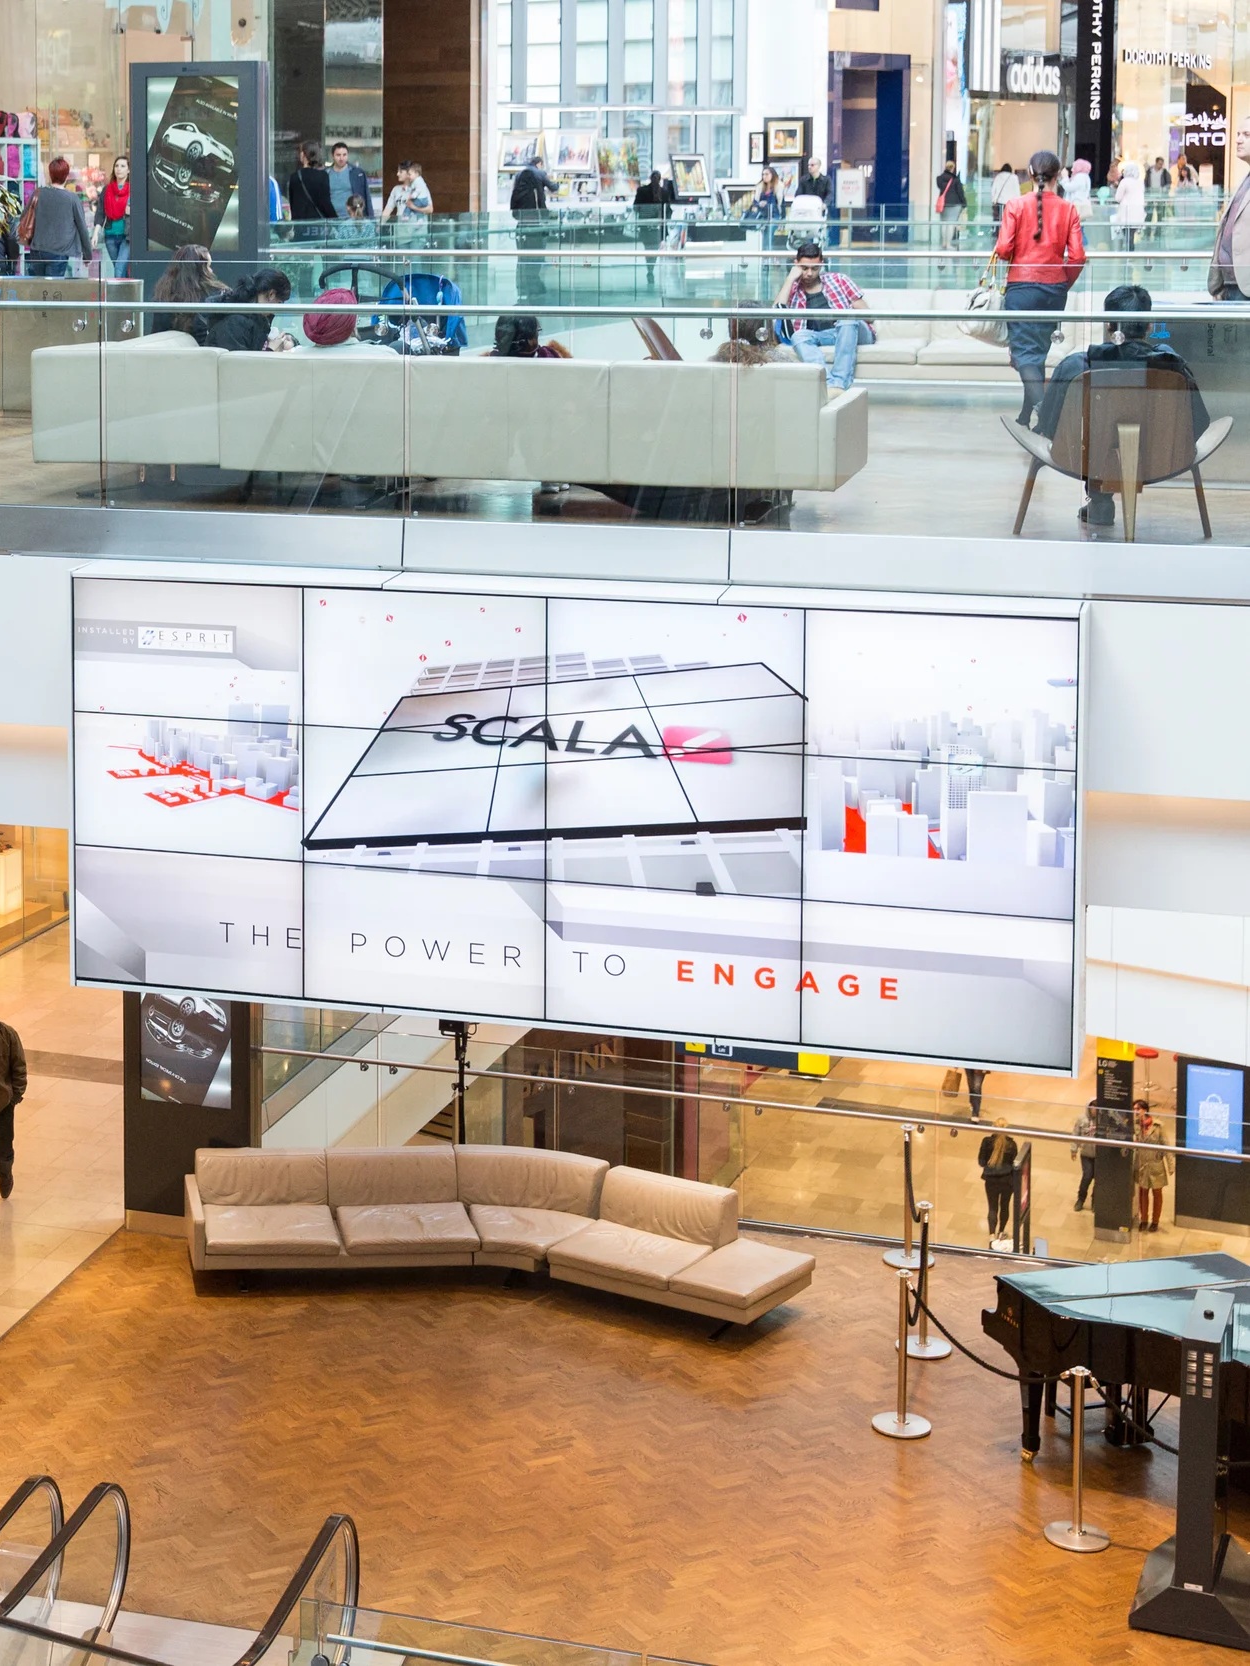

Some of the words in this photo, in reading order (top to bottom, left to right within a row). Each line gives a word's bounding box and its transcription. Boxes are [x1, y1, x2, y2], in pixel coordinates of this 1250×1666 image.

[1124, 49, 1170, 66] DOROTHY
[1171, 53, 1212, 70] PERKINS
[1008, 55, 1061, 95] adidas
[1090, 41, 1103, 121] PERKINS
[77, 626, 136, 636] INSTALLED
[122, 637, 136, 645] BY
[158, 630, 231, 644] ESPRIT
[431, 712, 659, 760] SCALA
[218, 920, 303, 951] THE
[350, 932, 522, 968] POWER
[572, 950, 627, 977] TO
[677, 959, 899, 1001] ENGAGE
